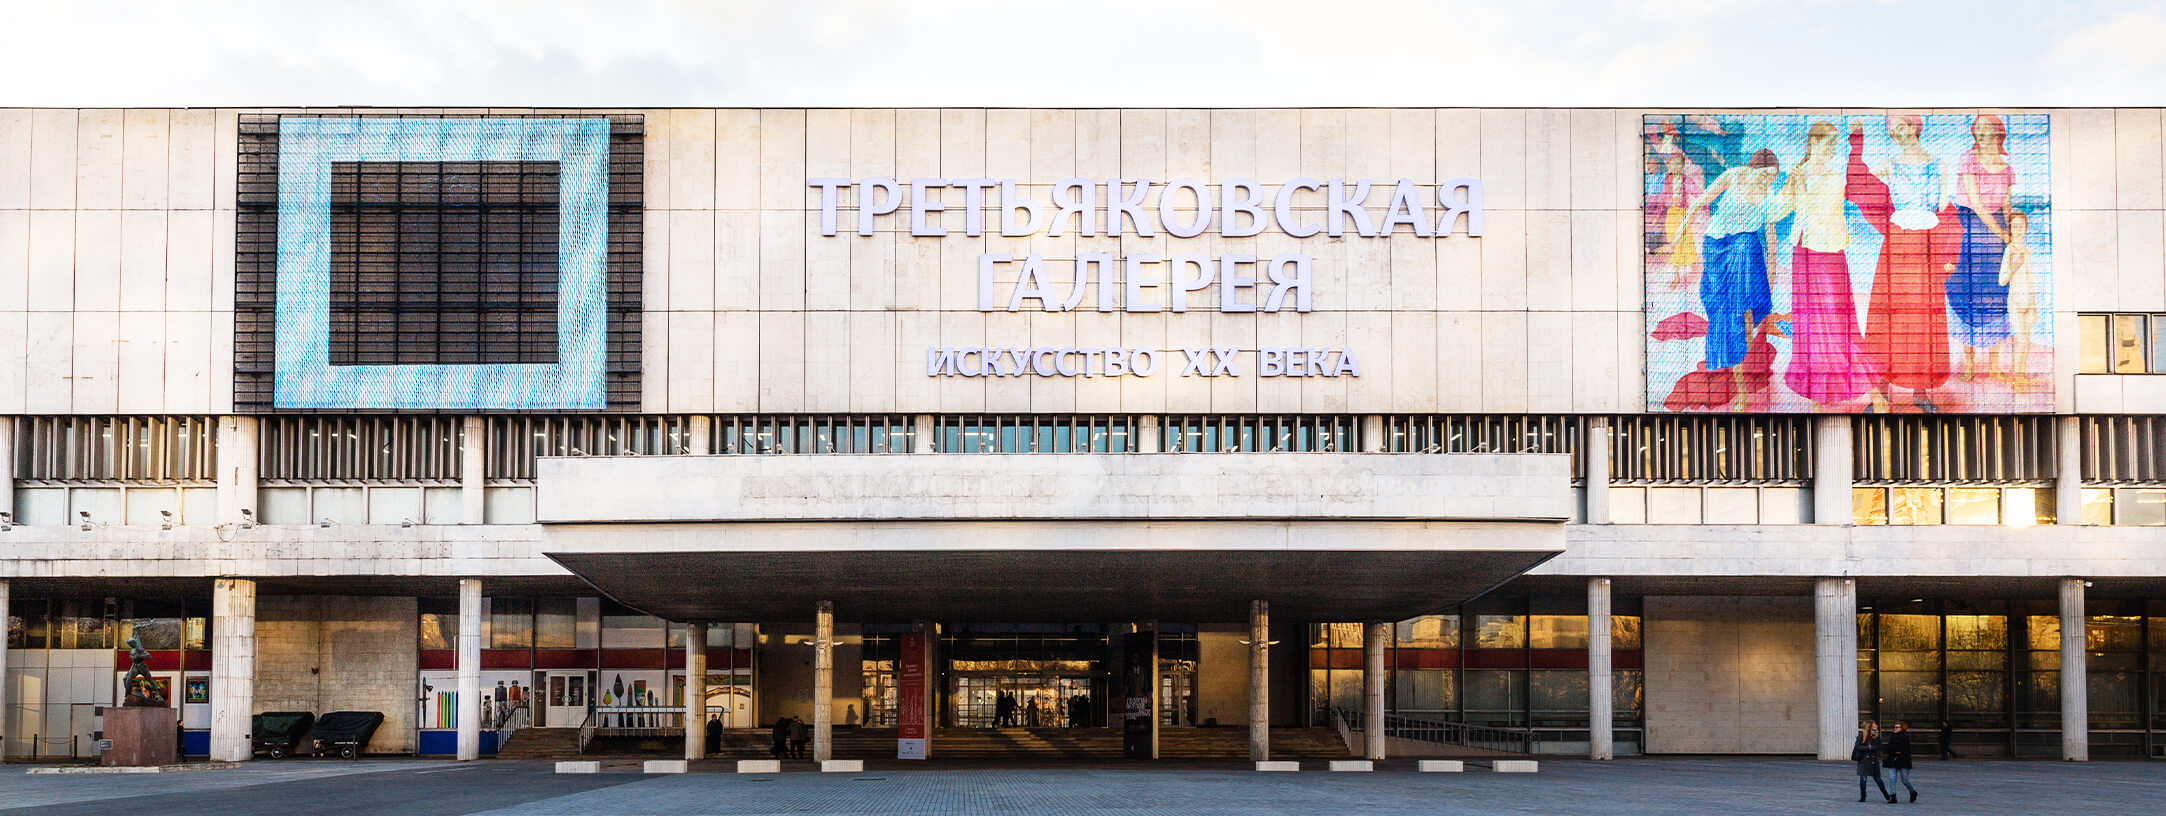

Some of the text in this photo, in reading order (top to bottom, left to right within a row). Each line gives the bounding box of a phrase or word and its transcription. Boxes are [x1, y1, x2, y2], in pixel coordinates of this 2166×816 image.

[808, 177, 1485, 237] ТРЕТЬЯКОВСКАЯ
[978, 253, 1313, 313] ГАЛЕРЕЯ
[927, 347, 1159, 378] ИСКУССТВО
[1260, 347, 1361, 377] ВЕКА
